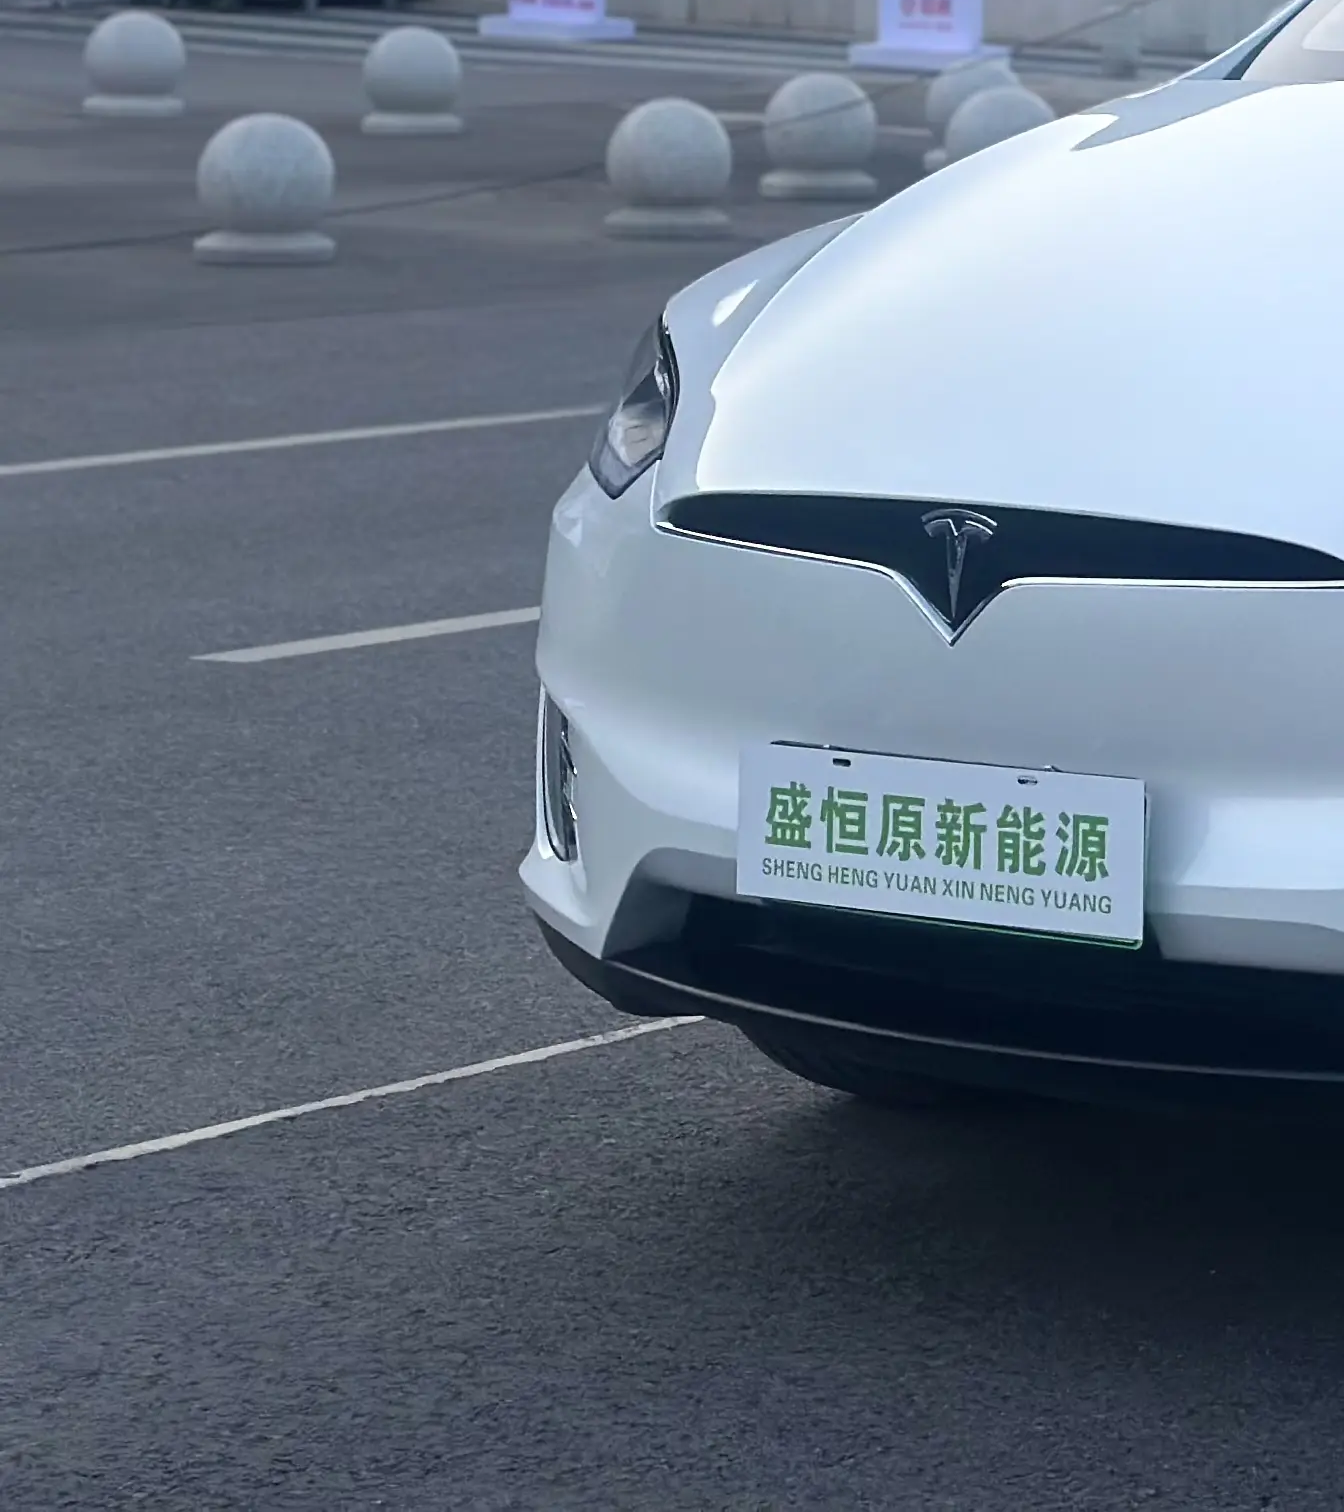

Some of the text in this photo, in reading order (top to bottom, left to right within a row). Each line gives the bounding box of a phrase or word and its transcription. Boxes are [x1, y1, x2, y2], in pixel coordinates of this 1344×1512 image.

[764, 780, 1110, 883] 盛恒原新能源
[761, 857, 1113, 915] SHENG HENG YUAN XIN NENG YUANG
